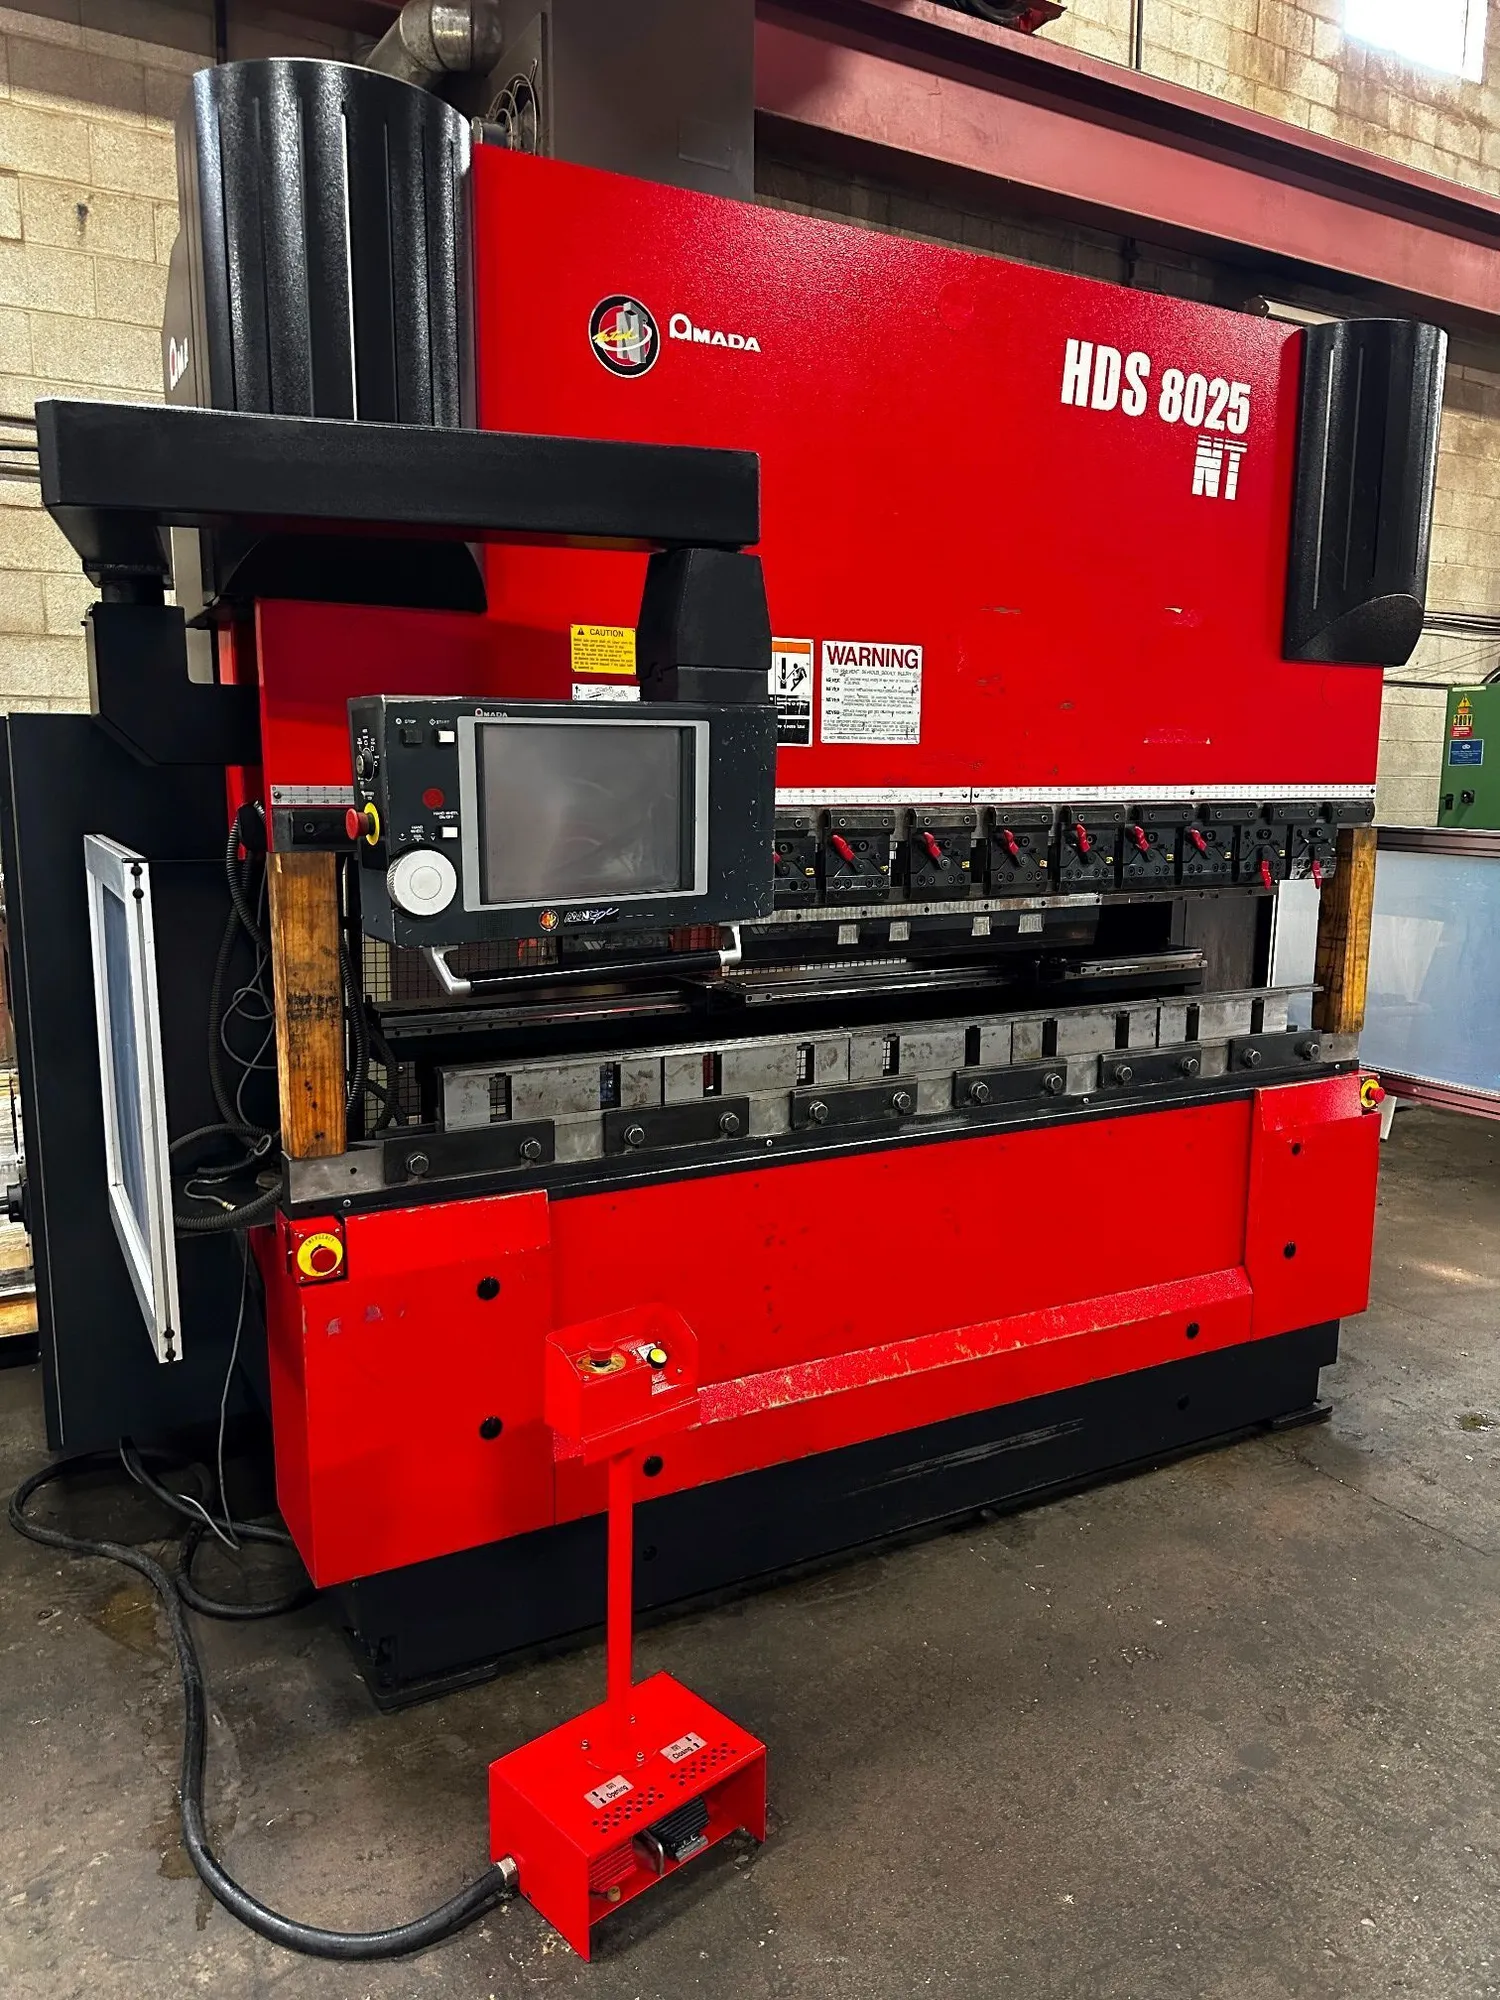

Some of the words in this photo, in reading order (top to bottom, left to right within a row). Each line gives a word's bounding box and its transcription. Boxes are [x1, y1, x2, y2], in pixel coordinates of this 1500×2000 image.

[1061, 338, 1151, 417] HDS
[1158, 368, 1251, 434] 8025
[1192, 434, 1248, 500] NT
[589, 628, 624, 637] CAUTION
[827, 645, 918, 669] WARNING
[672, 1745, 694, 1759] Closing
[606, 1784, 629, 1799] Opening
